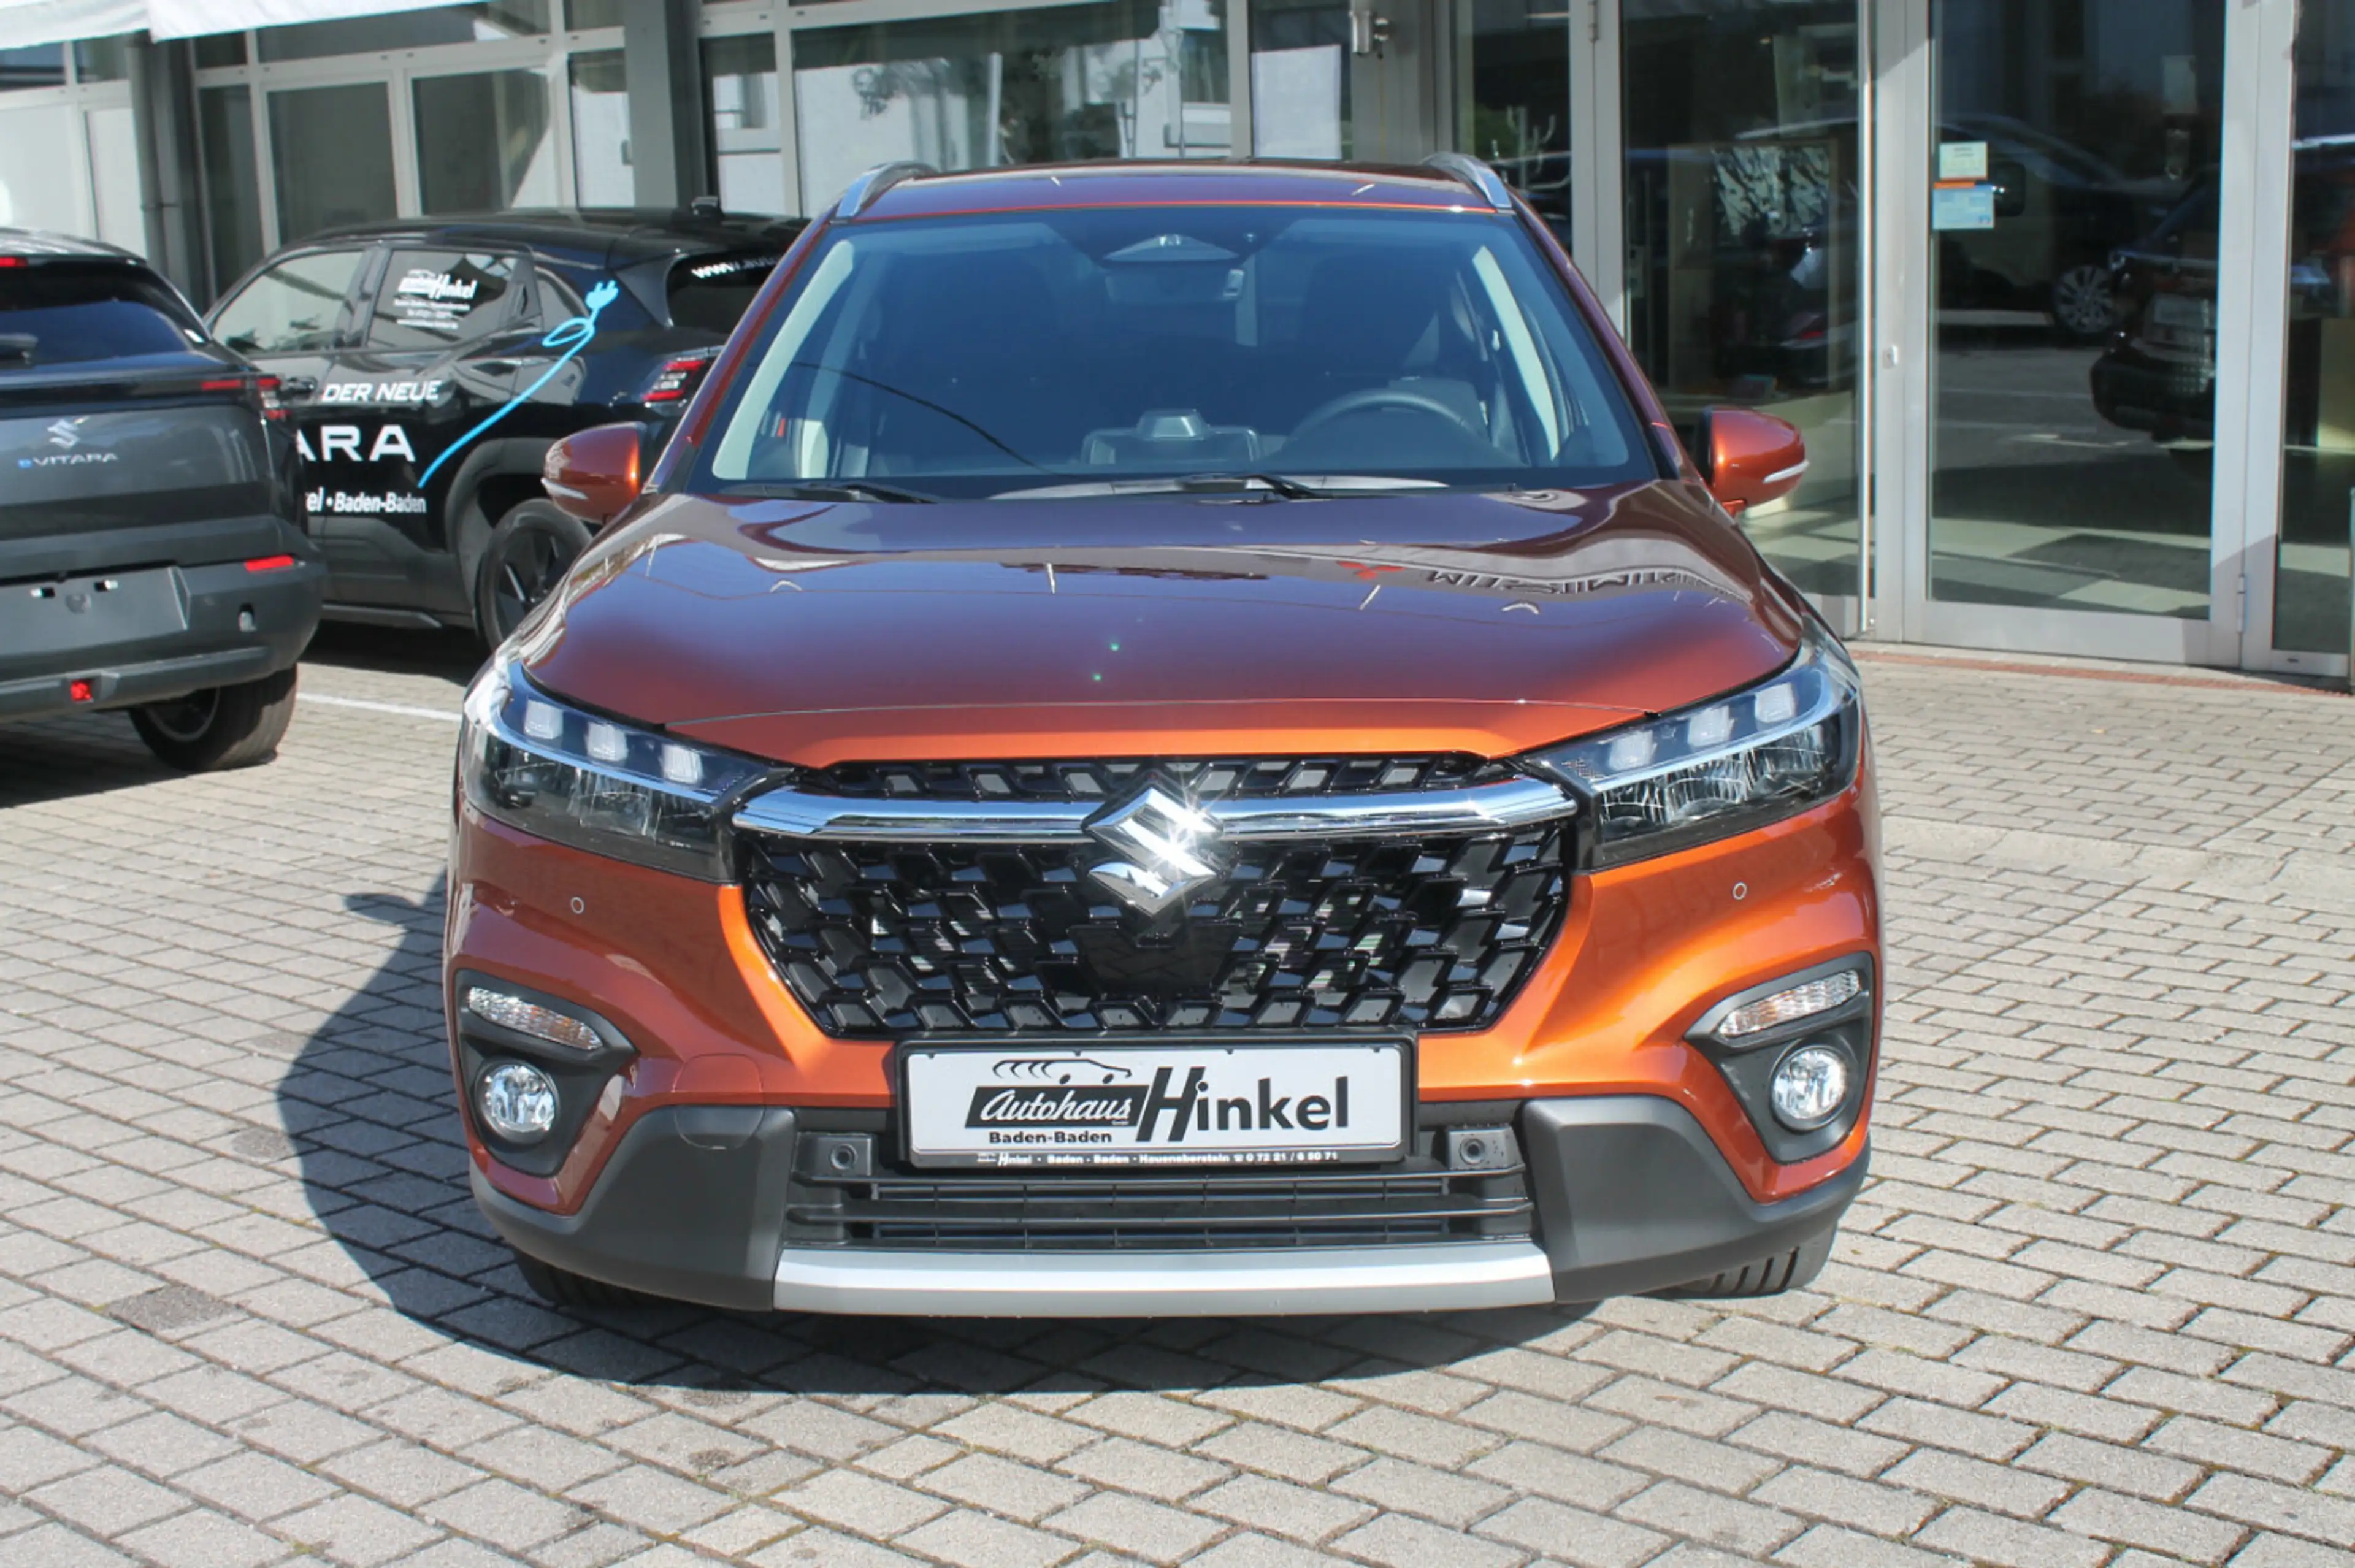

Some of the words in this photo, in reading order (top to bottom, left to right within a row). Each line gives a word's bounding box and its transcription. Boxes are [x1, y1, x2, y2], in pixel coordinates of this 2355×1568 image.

[321, 383, 372, 402] DER
[375, 381, 442, 402] NEUE
[305, 486, 325, 512] el
[333, 492, 427, 513] Baden-Baden
[981, 1089, 1132, 1122] Autohaus
[1136, 1066, 1348, 1142] Hinkel
[989, 1131, 1112, 1143] Baden-Baden
[1047, 1154, 1084, 1163] Baden
[1093, 1154, 1130, 1163] Baden
